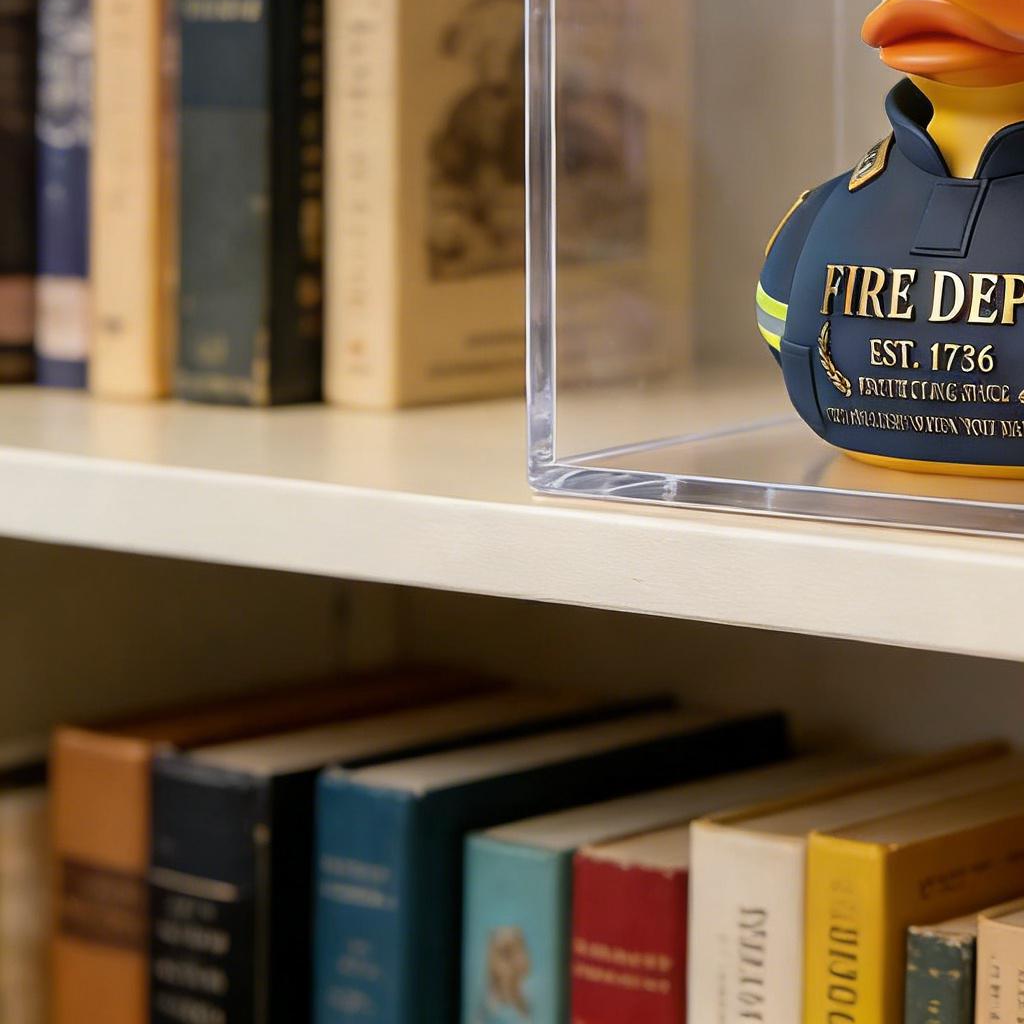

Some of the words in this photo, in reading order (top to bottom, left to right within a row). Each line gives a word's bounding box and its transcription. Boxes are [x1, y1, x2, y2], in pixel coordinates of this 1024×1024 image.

[820, 263, 916, 319] FIRE
[869, 339, 919, 370] EST.
[929, 342, 995, 373] 1736
